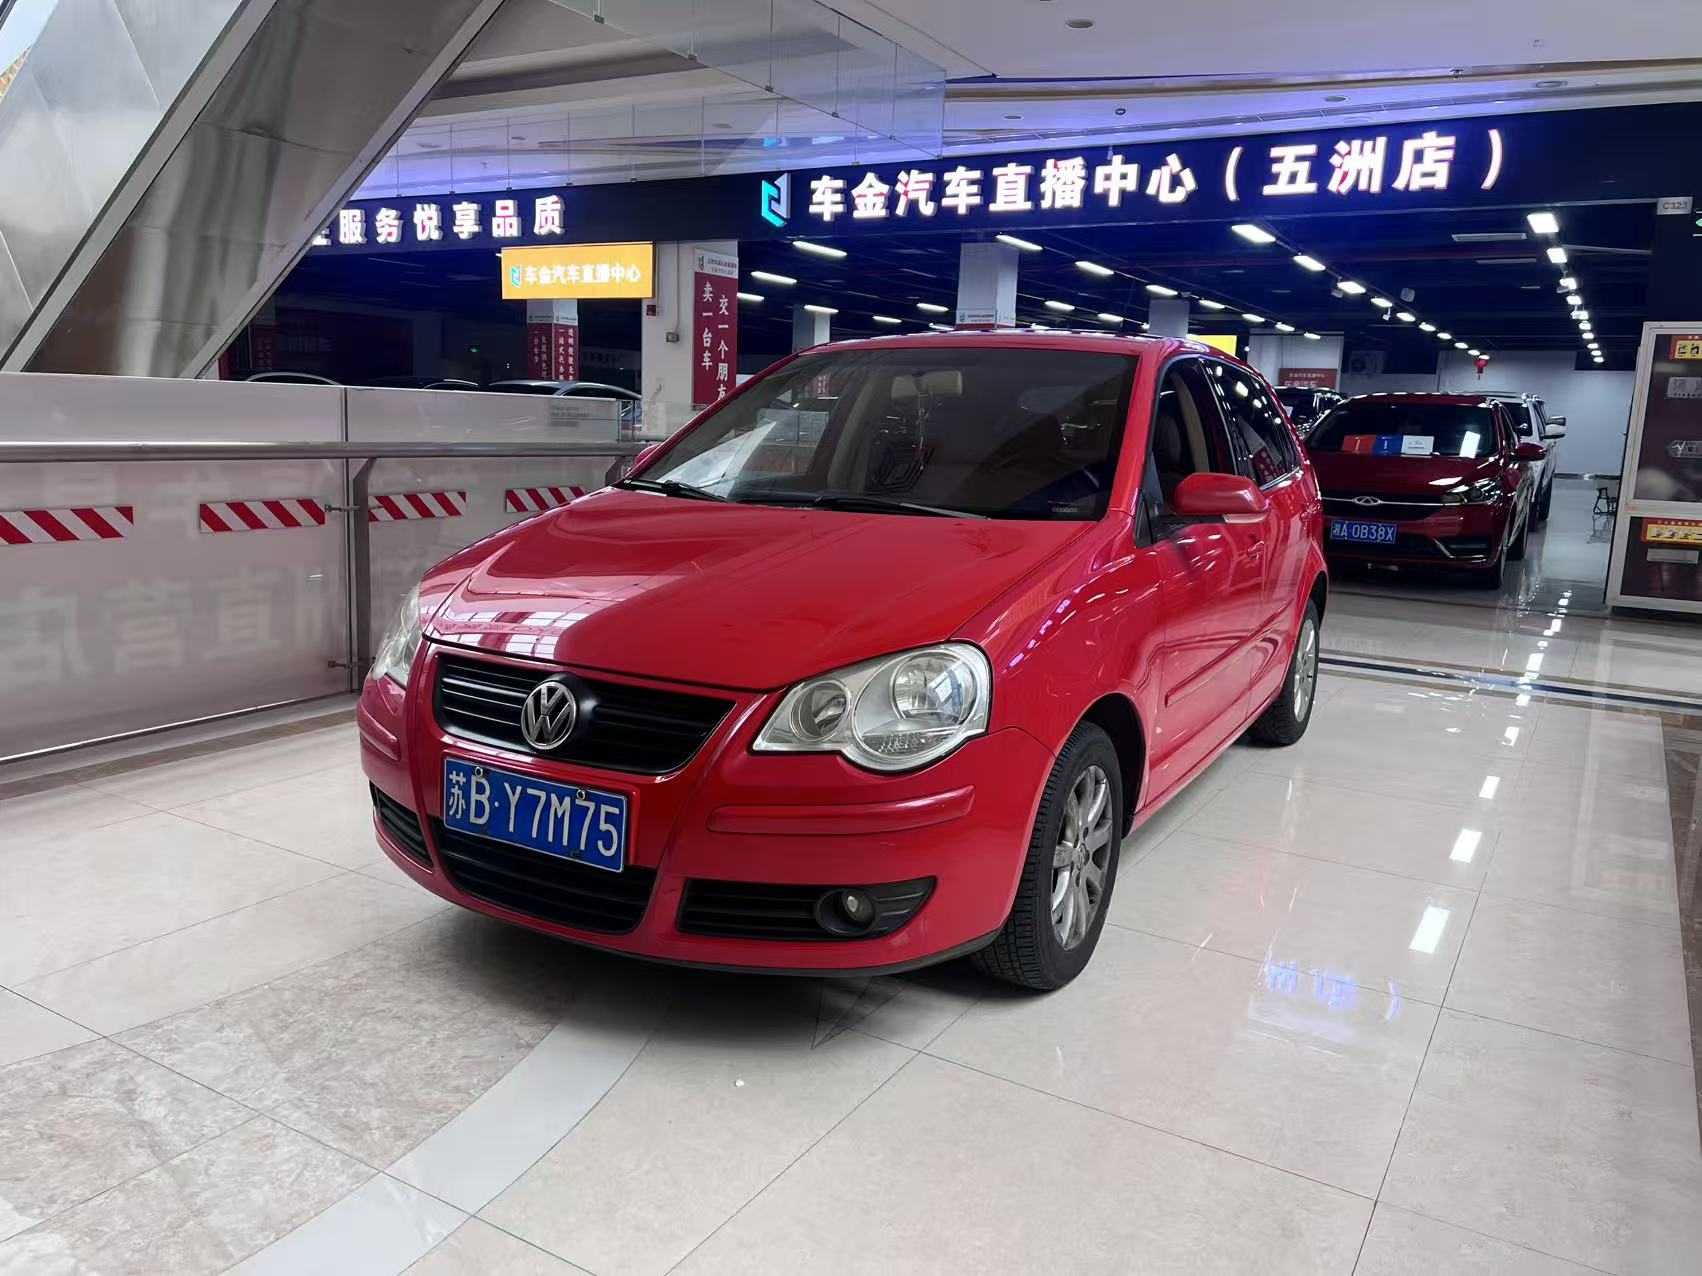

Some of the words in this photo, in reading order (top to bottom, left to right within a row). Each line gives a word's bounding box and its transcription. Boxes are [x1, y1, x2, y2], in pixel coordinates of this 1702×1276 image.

[525, 263, 641, 284] 车金汽车直播中心
[701, 281, 714, 371] 卖一台车
[716, 295, 729, 402] 交一个朋友
[448, 769, 620, 858] 苏B·Y7M75
